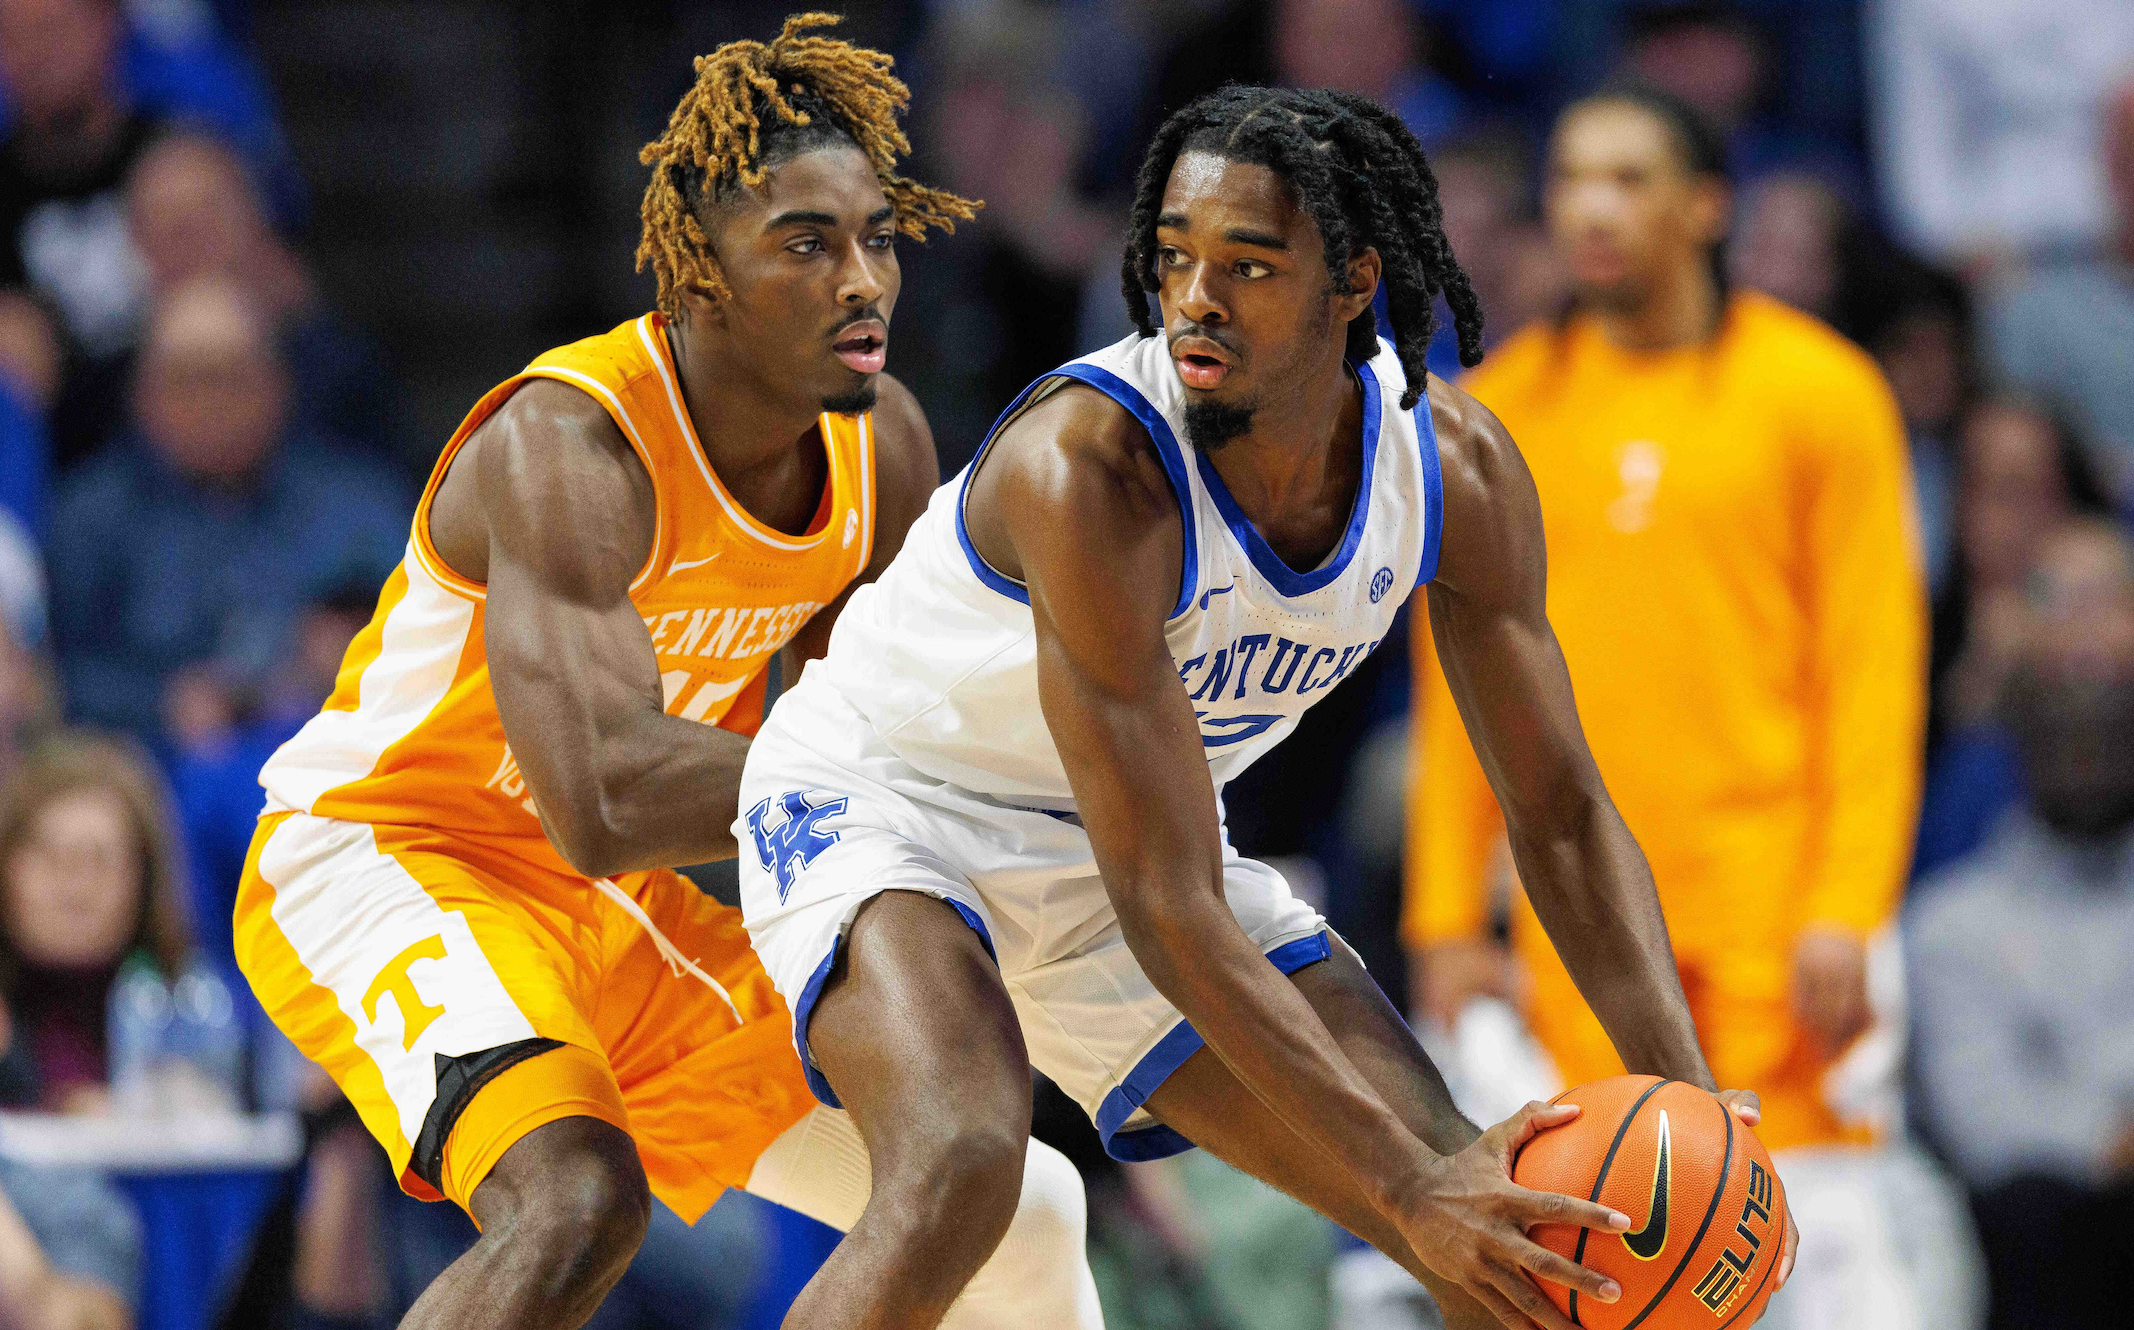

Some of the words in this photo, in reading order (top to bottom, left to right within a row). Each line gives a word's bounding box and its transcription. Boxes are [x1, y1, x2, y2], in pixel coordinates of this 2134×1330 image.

[642, 601, 825, 660] ENNESSE
[1370, 567, 1393, 603] SEC
[1173, 633, 1382, 702] ENTUCK
[360, 933, 448, 1053] T
[1691, 1157, 1772, 1313] ELITE
[1715, 1180, 1778, 1319] CHAMPION
